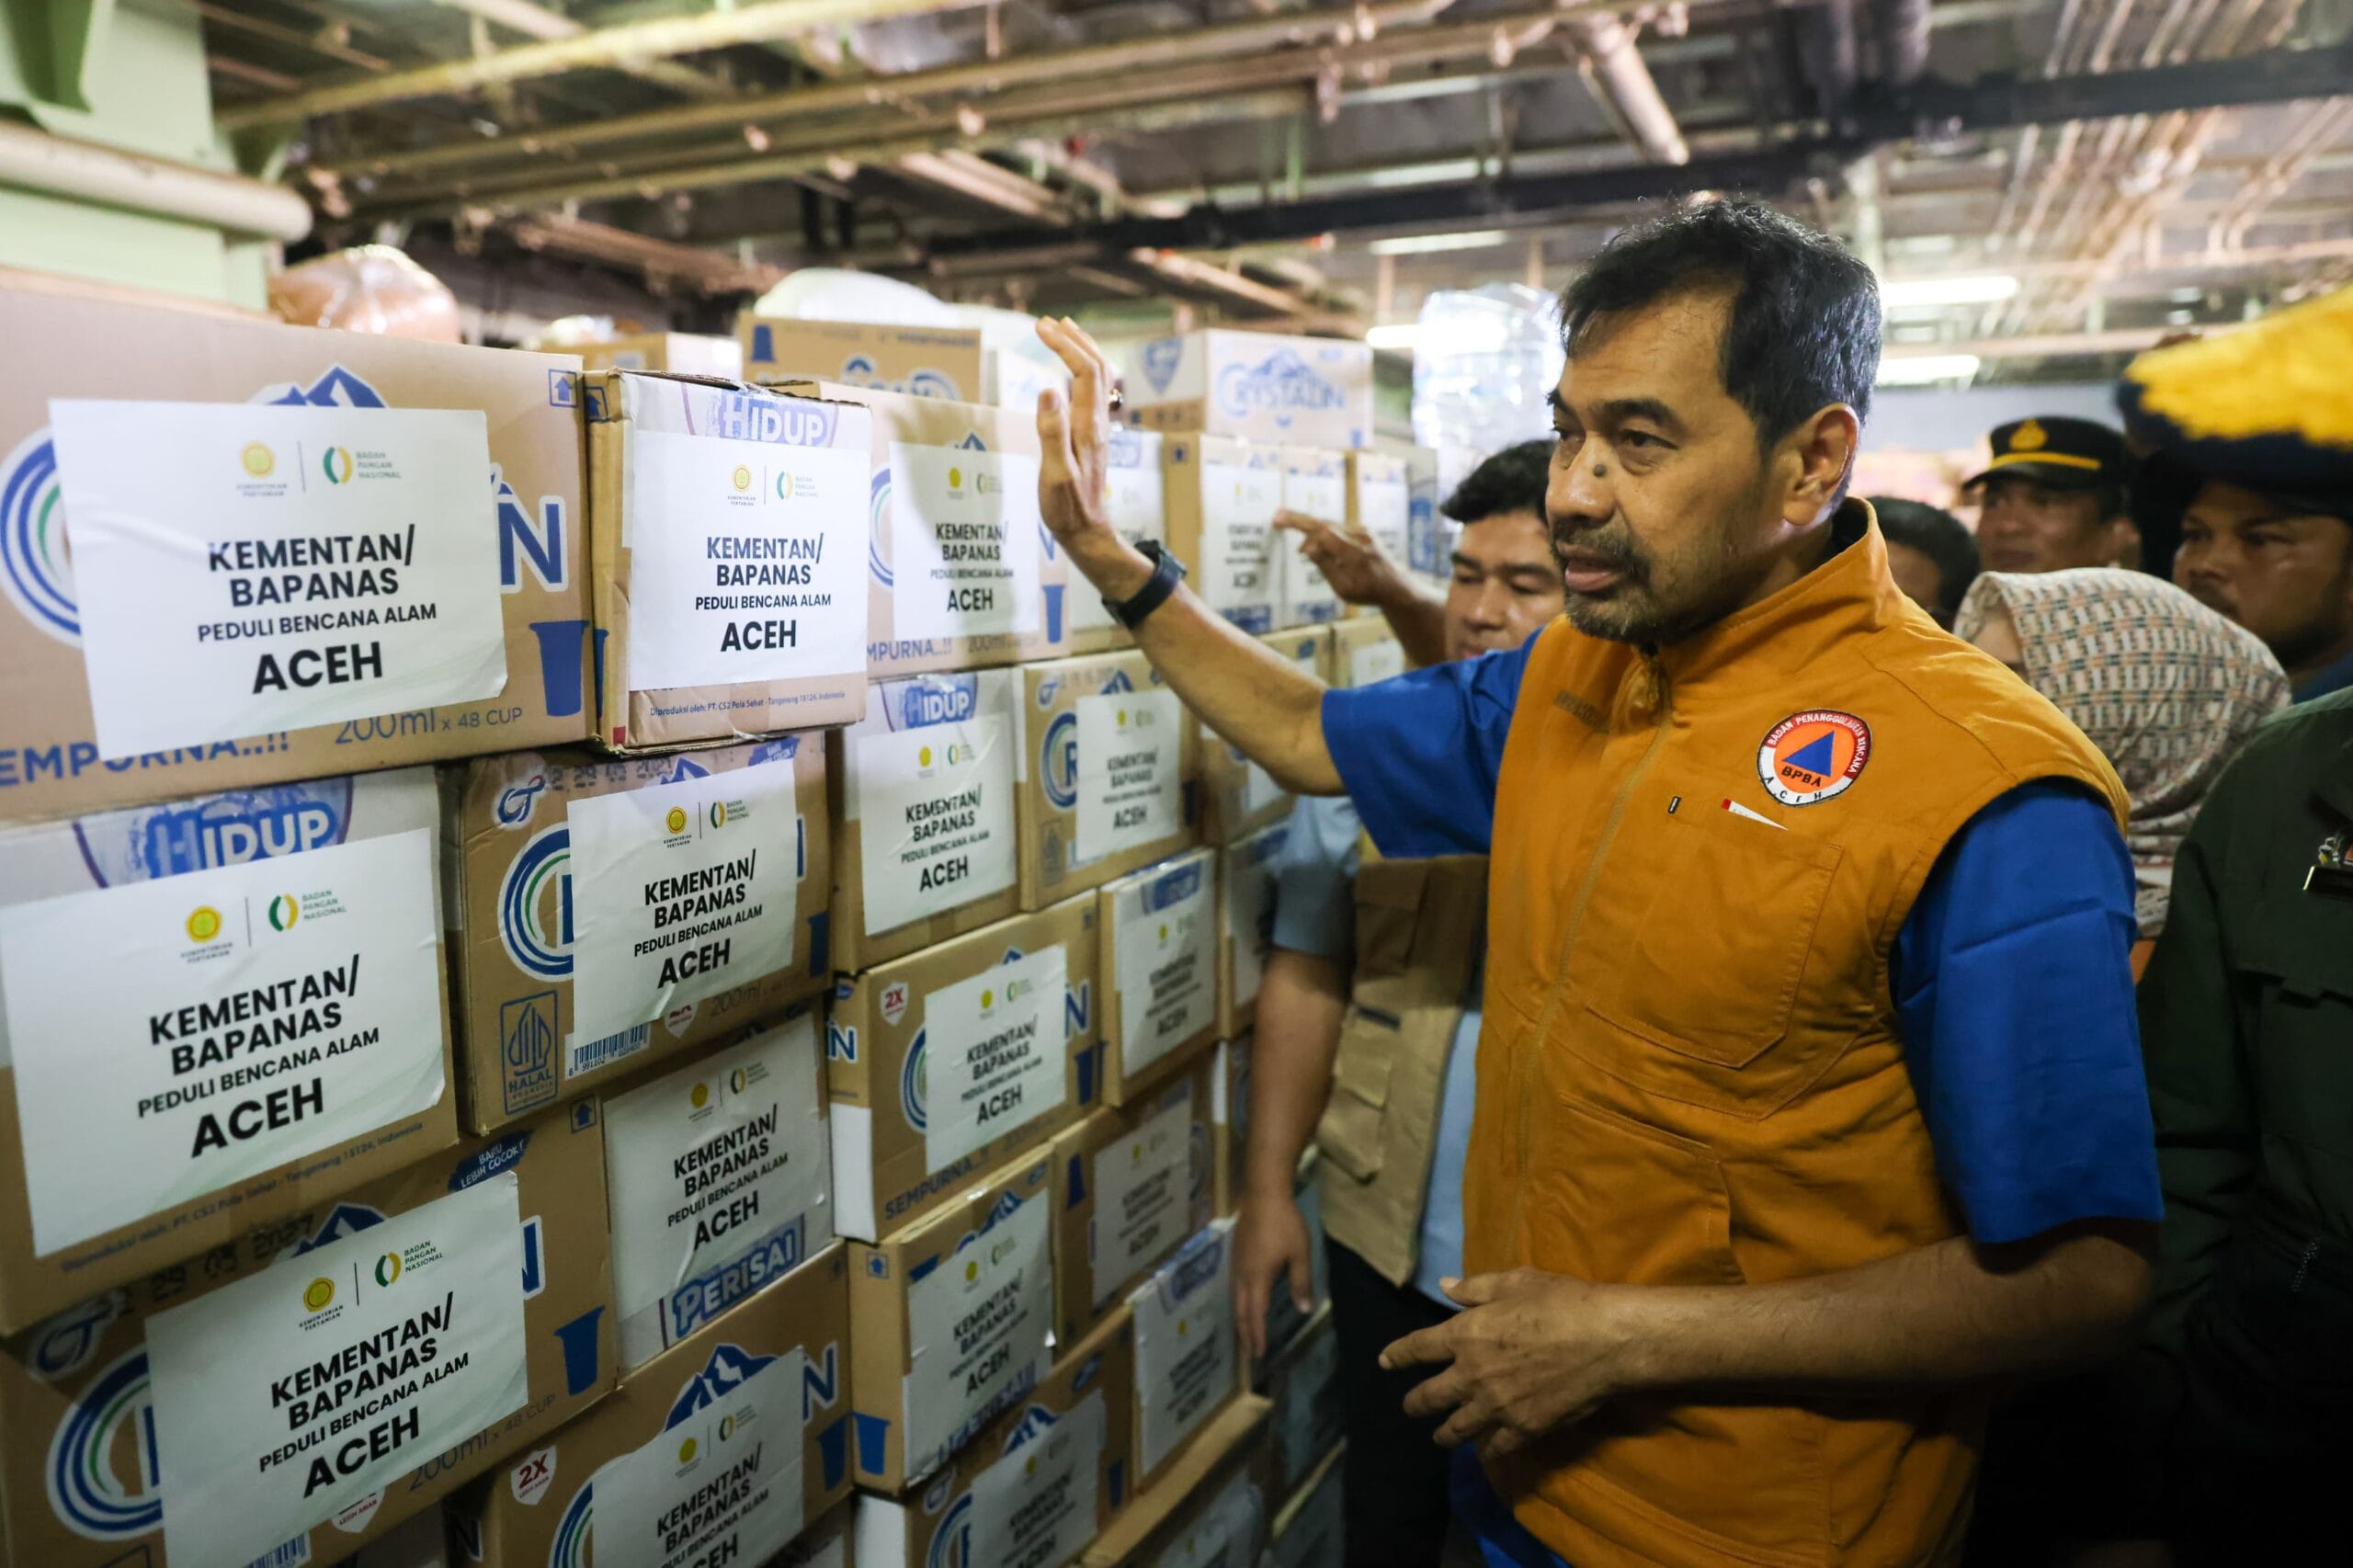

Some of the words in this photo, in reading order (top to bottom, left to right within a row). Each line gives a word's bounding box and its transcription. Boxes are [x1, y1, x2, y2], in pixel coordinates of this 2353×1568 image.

[721, 390, 825, 448] HIDUP
[209, 524, 415, 572] KEMENTAN/
[707, 532, 824, 564] KEMENTAN/
[936, 520, 1009, 545] KEMENTAN/
[942, 544, 1001, 562] BAPANAS
[230, 567, 399, 608] BAPANAS
[716, 564, 812, 586] BAPANAS
[695, 596, 738, 610] PEDULI
[741, 595, 798, 608] BENCANA
[800, 594, 831, 607] ALAM
[947, 588, 995, 612] ACEH
[198, 619, 274, 642] PEDULI
[279, 609, 380, 635] BENCANA
[384, 603, 437, 624] ALAM
[720, 619, 797, 653] ACEH
[252, 642, 383, 695] ACEH
[458, 712, 480, 729] 48
[486, 707, 522, 726] CUP
[1767, 721, 1794, 746] BADAN
[1781, 766, 1822, 787] BPBA
[905, 781, 983, 824] KEMENTAN/
[1112, 805, 1147, 831] ACEH
[912, 810, 975, 843] BAPANAS
[644, 847, 756, 906] KEMENTAN/
[919, 855, 969, 892] ACEH
[654, 882, 746, 929] BAPANAS
[634, 932, 676, 958] PEDULI
[678, 915, 733, 943] BENCANA
[733, 903, 763, 926] ALAM
[656, 937, 732, 989] ACEH
[149, 953, 360, 1046] KEMENTAN/
[885, 986, 904, 1010] 2X
[171, 1002, 342, 1076] BAPANAS
[137, 1078, 215, 1118] PEDULI
[221, 1047, 322, 1092] BENCANA
[326, 1028, 380, 1058] ALAM
[508, 1068, 553, 1093] HALAL
[972, 1040, 1030, 1081] BAPANAS
[190, 1077, 324, 1158] ACEH
[976, 1083, 1023, 1126] ACEH
[478, 1143, 503, 1165] BARU
[673, 1103, 778, 1180] KEMENTAN/
[460, 1165, 487, 1189] LEBIH
[684, 1137, 769, 1199] BAPANAS
[667, 1197, 706, 1228] PEDULI
[708, 1170, 758, 1206] BENCANA
[761, 1152, 789, 1177] ALAM
[693, 1190, 759, 1252] ACEH
[404, 1241, 430, 1256] BADAN
[404, 1246, 437, 1265] PANGAN
[404, 1252, 443, 1273] NASIONAL
[673, 1229, 795, 1338] PERISAI
[271, 1291, 454, 1409] KEMENTAN/
[965, 1342, 1010, 1397] ACEH
[289, 1337, 438, 1432] BAPANAS
[258, 1426, 326, 1472] PEDULI
[331, 1382, 419, 1437] BENCANA
[422, 1352, 469, 1389] ALAM
[526, 1394, 556, 1418] CUP
[303, 1406, 419, 1499] ACEH
[518, 1452, 548, 1489] 2X
[657, 1441, 762, 1538] KEMENTAN/
[741, 1487, 769, 1517] ALAM
[665, 1478, 750, 1555] BAPANAS
